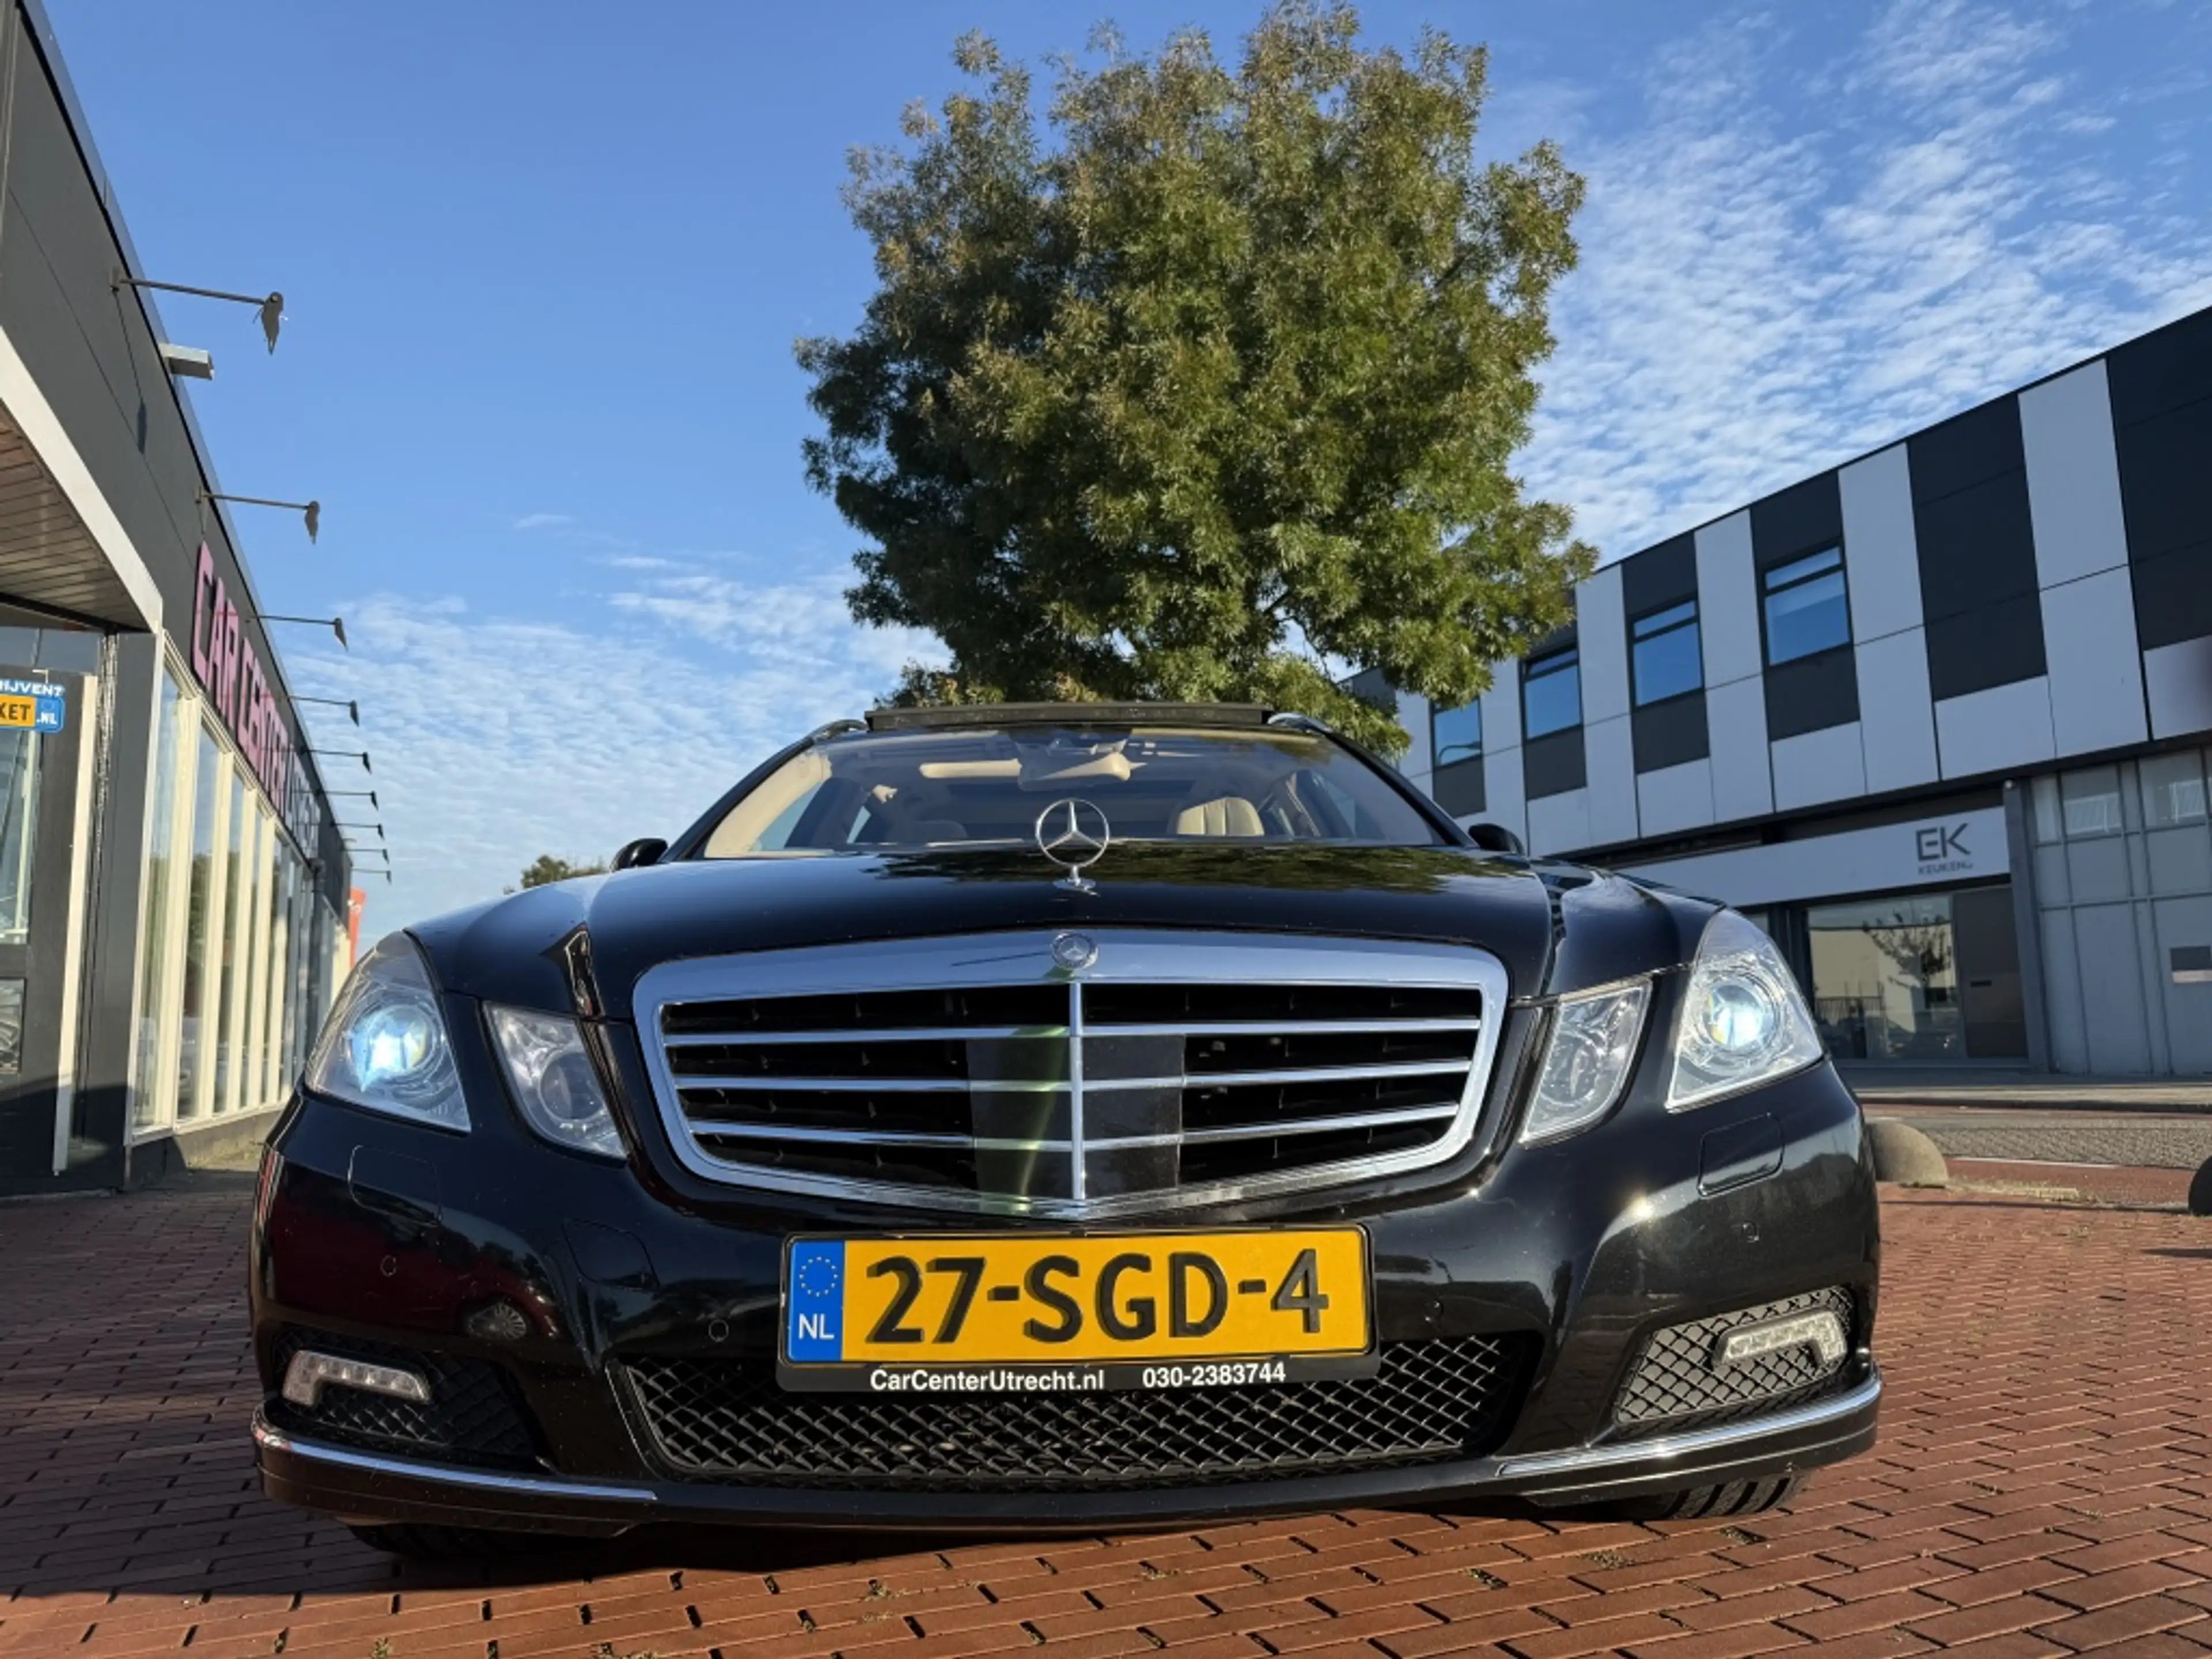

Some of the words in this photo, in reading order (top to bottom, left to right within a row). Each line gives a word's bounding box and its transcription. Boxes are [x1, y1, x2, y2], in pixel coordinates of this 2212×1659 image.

[193, 540, 240, 729] CAR
[1916, 823, 1971, 861] EK
[798, 1313, 834, 1340] NL
[865, 1248, 1329, 1344] 27-SGD-4
[870, 1369, 1104, 1391] CarCenterUtrecht.nl
[1142, 1362, 1286, 1388] 030-2383744
